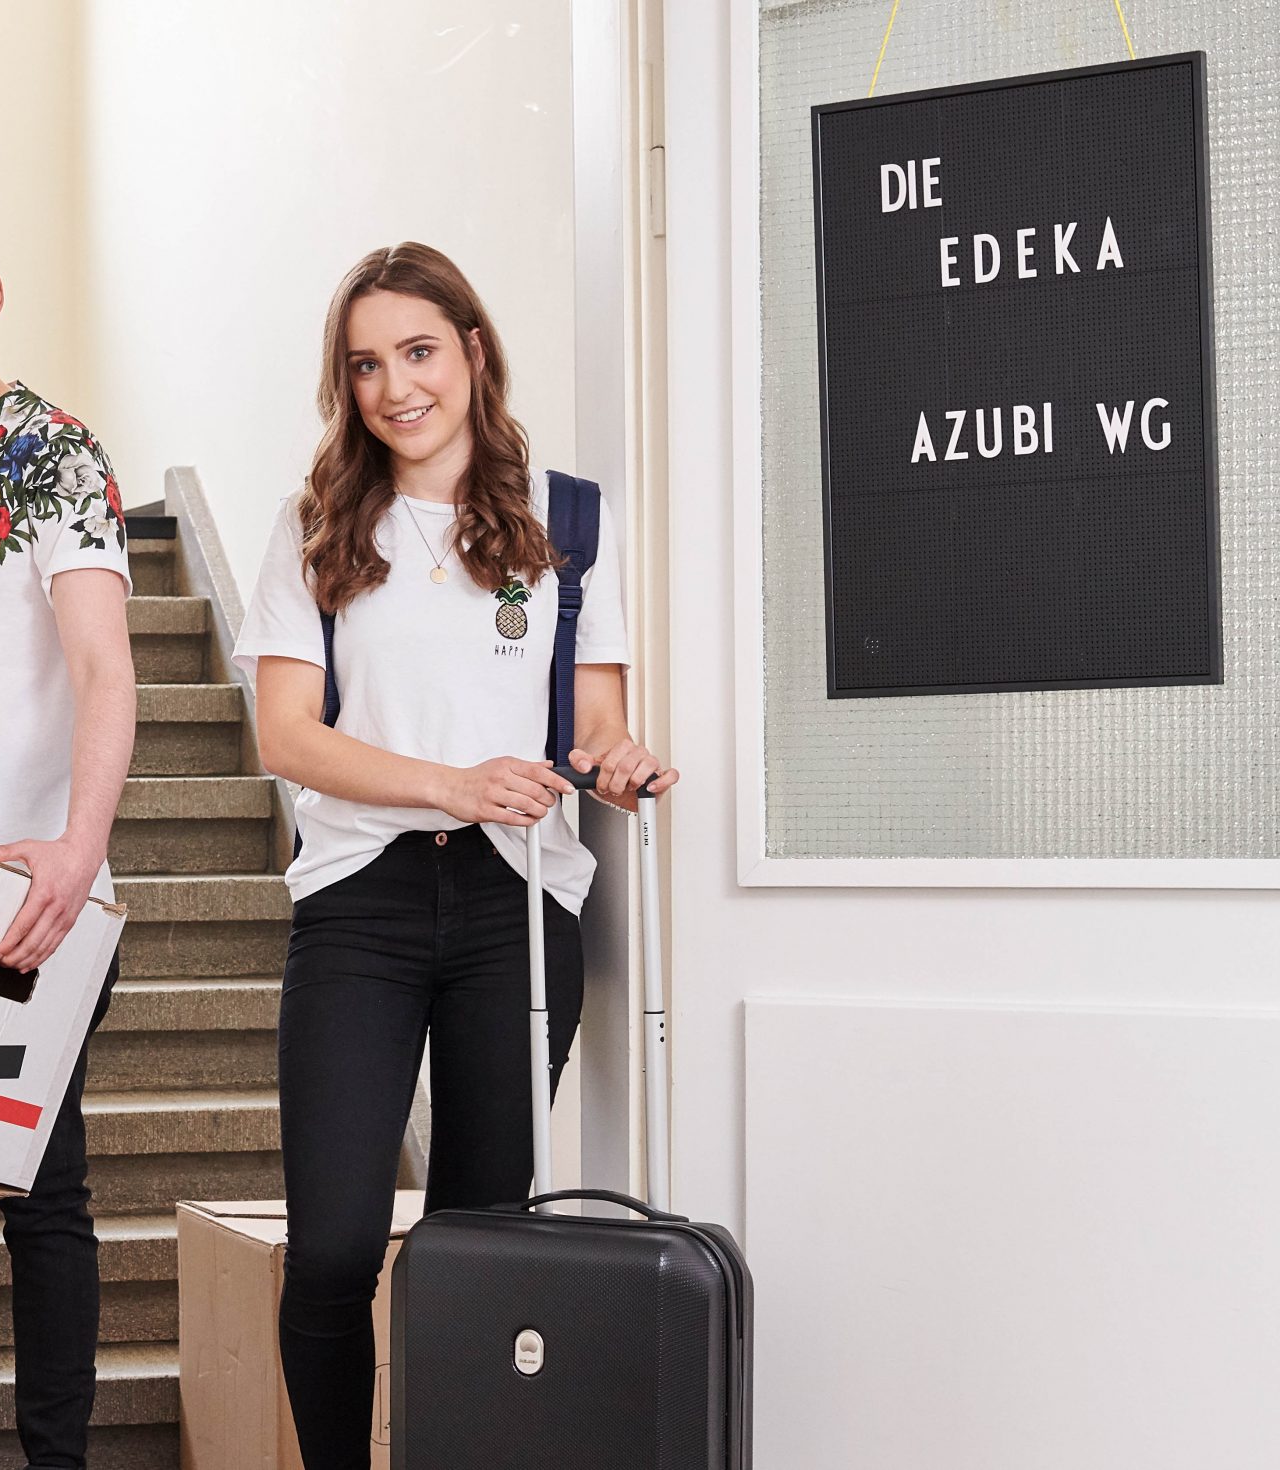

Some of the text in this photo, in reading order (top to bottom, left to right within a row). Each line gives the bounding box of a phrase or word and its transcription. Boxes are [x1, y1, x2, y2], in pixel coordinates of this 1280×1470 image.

[880, 157, 943, 213] DIE
[940, 216, 1125, 288] EDEKA
[910, 397, 1172, 463] AZUBI WG
[494, 645, 524, 658] HAPPY
